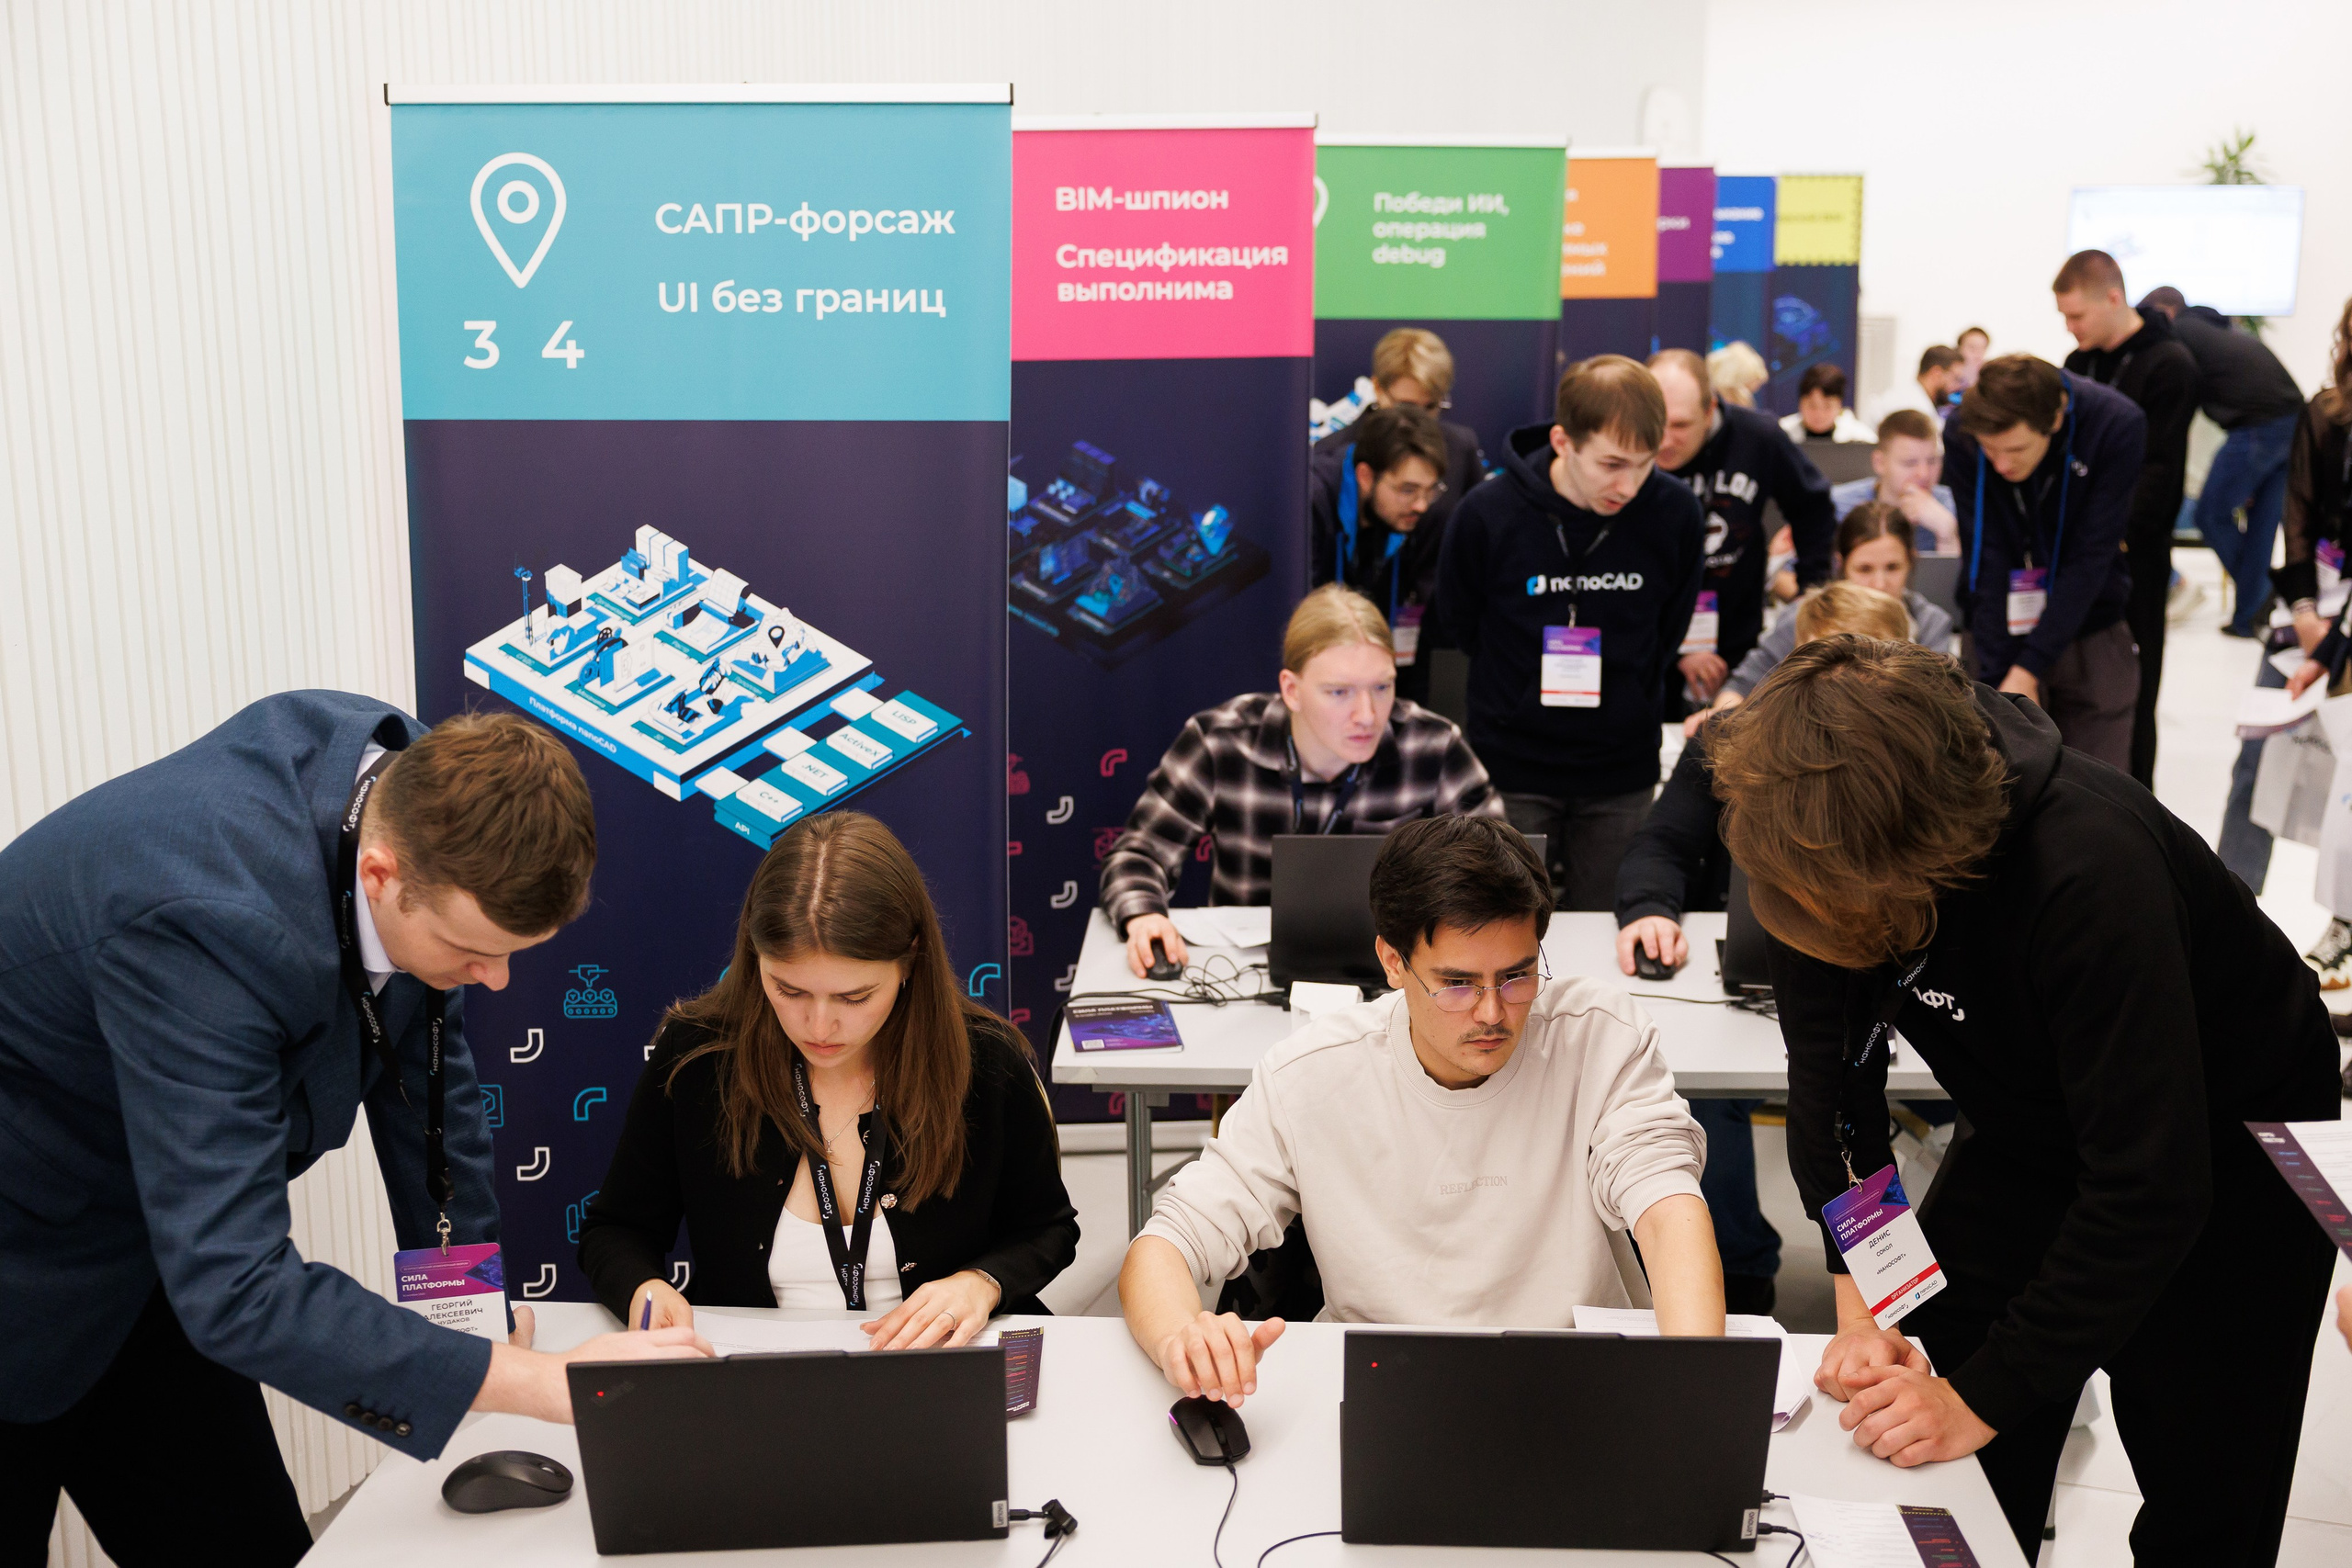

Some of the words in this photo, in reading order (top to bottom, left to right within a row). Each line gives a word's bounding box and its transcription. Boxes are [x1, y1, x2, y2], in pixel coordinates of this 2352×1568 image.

[1056, 186, 1228, 211] BIM-шпион
[1374, 191, 1464, 215] Победи
[655, 202, 956, 241] САПР-форсаж
[1373, 221, 1487, 243] операция
[1056, 243, 1288, 272] Спецификация
[1372, 243, 1446, 268] debug
[658, 282, 698, 313] UI
[712, 279, 784, 313] без
[797, 288, 947, 320] границ
[1057, 279, 1233, 302] выполнима
[463, 321, 501, 369] 3
[541, 321, 585, 369] 4
[529, 695, 578, 731] Платформа
[578, 725, 617, 755] nanoCAD
[891, 709, 918, 726] LISP
[839, 732, 881, 758] ActiveX
[801, 764, 829, 779] .NET
[759, 791, 779, 805] C++
[734, 821, 750, 836] API
[1837, 1216, 1857, 1233] СИЛА
[1840, 1208, 1883, 1241] ПЛАТФОРМЫ
[1868, 1229, 1892, 1249] ДЕНИС
[1876, 1242, 1894, 1258] СОКОЛ
[401, 1273, 428, 1282] СИЛА
[402, 1279, 466, 1292] ПЛАТФОРМЫ
[1891, 1277, 1919, 1301] ОРГАНИЗАТОР
[424, 1307, 483, 1321] АЛЕКСЕЕВИЧ
[431, 1299, 473, 1312] ГЕОРГИЙ
